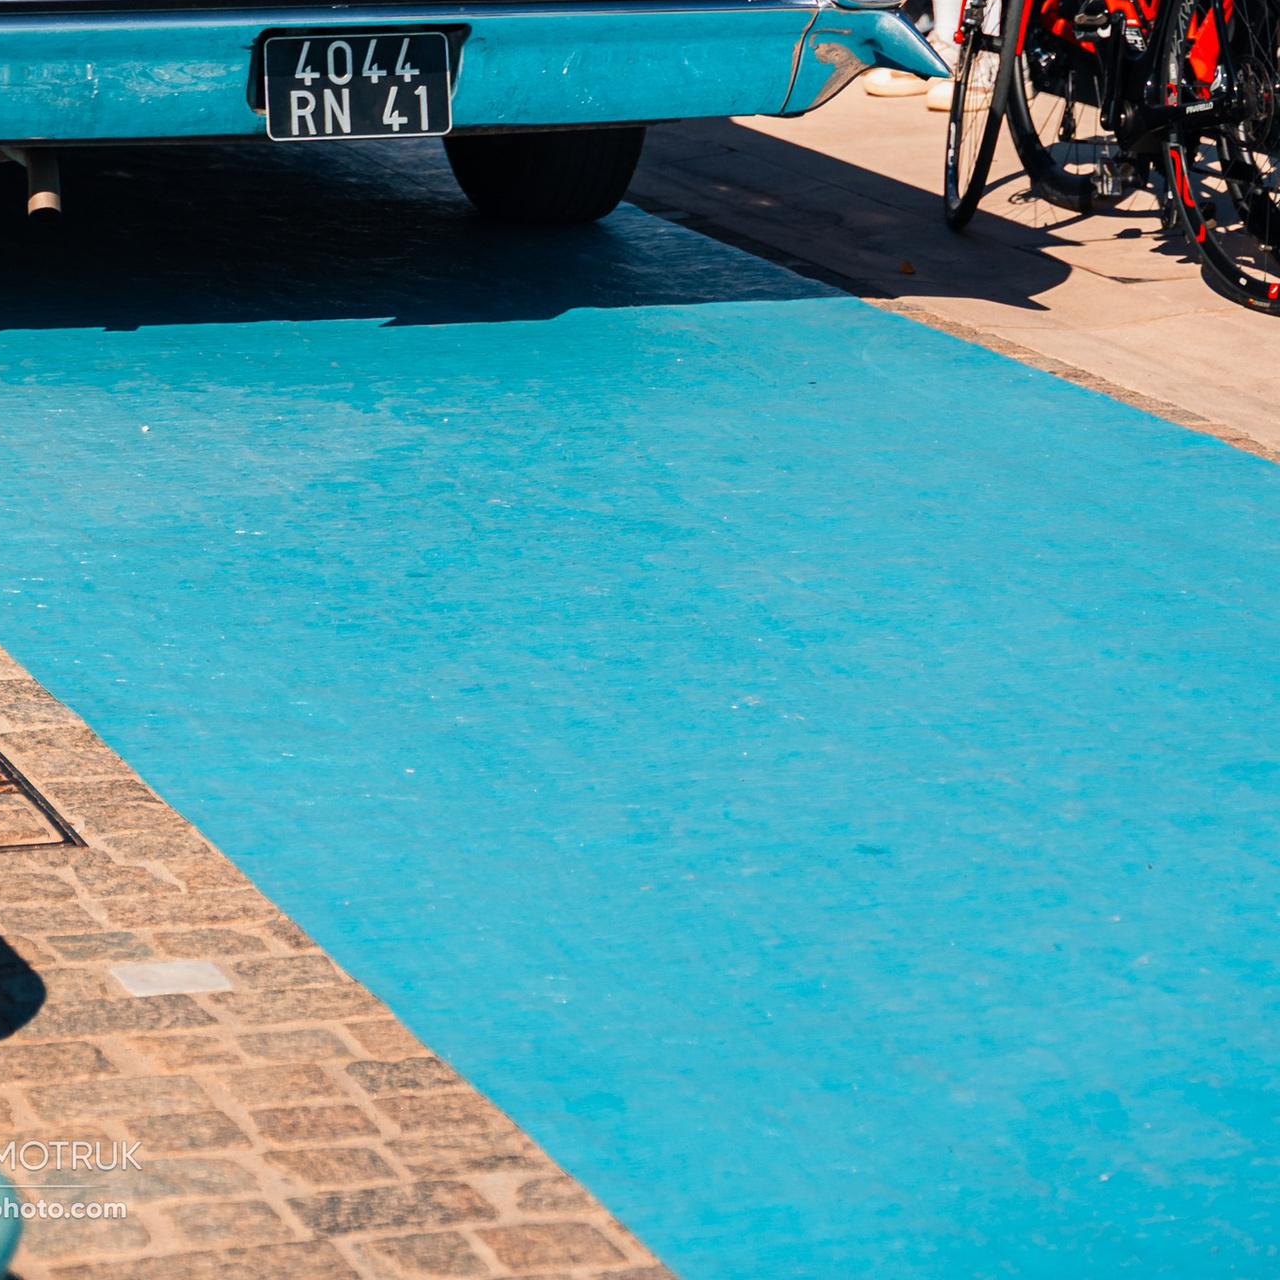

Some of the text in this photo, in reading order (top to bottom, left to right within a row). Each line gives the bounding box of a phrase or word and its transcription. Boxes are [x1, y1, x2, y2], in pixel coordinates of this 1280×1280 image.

[294, 38, 420, 86] 4044
[290, 85, 429, 136] RN 41
